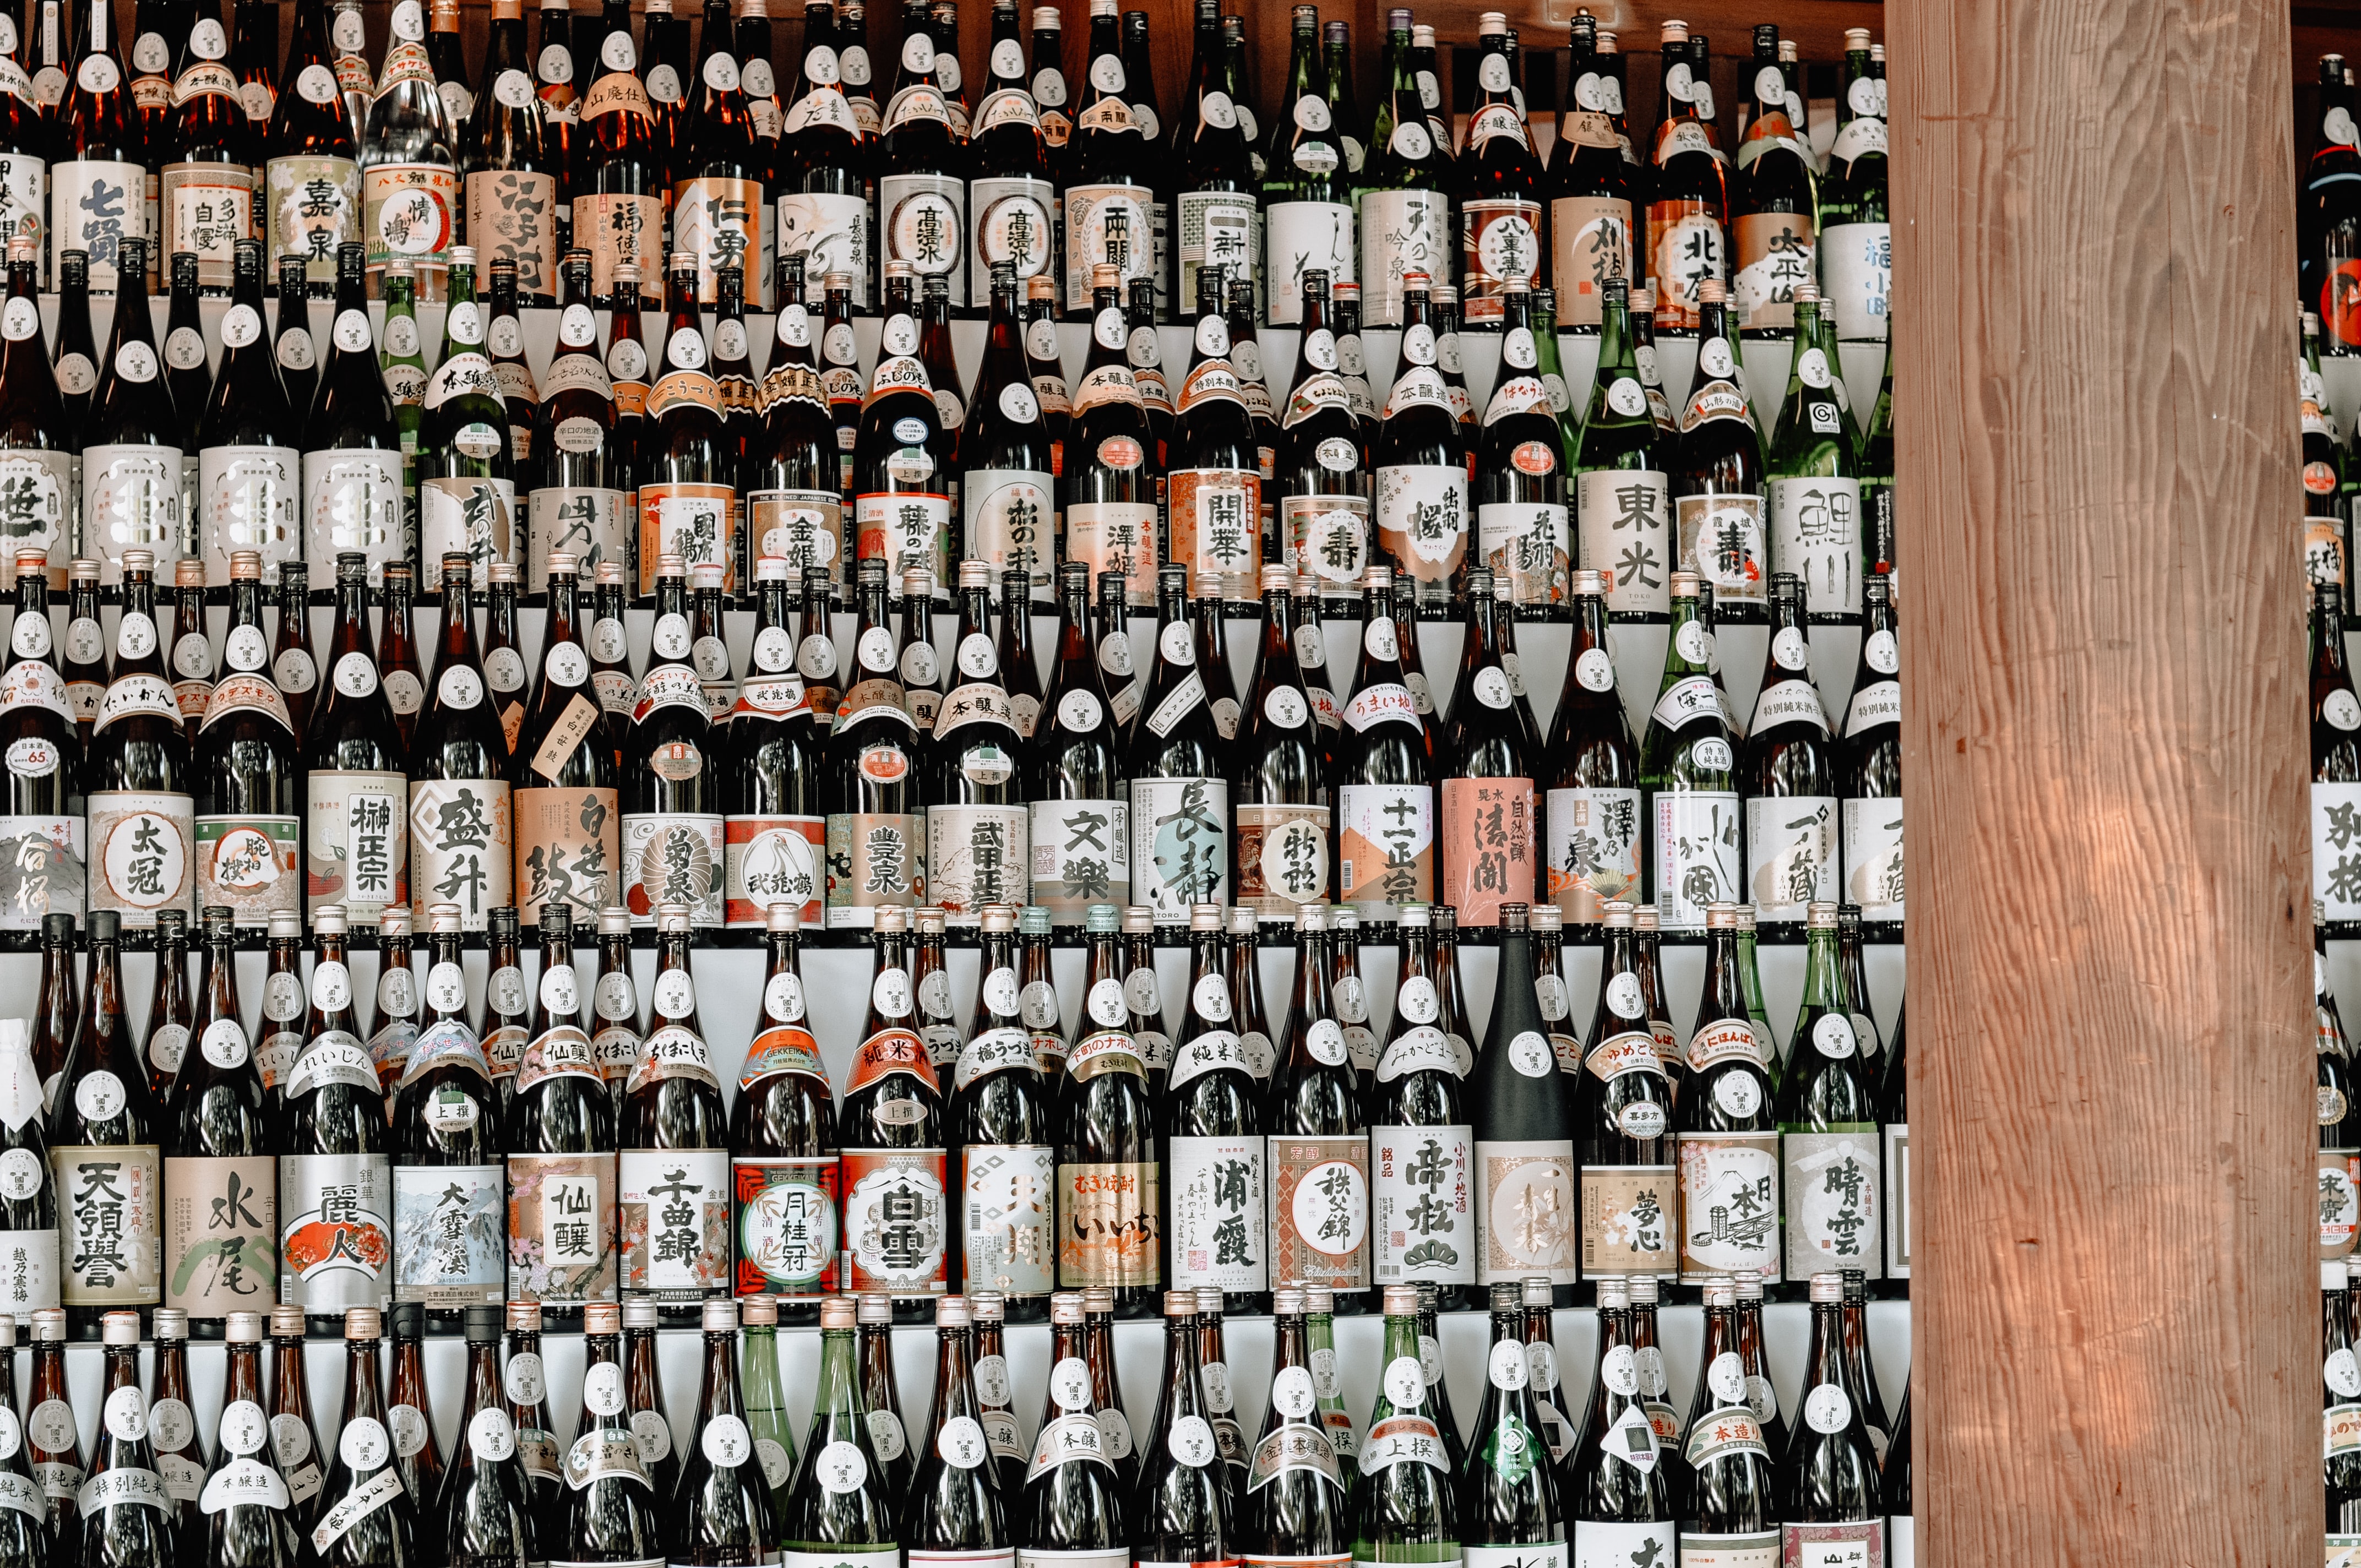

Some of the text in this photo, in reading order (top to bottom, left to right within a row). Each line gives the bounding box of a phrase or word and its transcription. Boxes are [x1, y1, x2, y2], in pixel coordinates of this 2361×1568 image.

[80, 178, 124, 268] 七賢
[301, 178, 341, 263] 嘉泉
[706, 195, 750, 270] 仁勇
[558, 426, 600, 436] 辛口の地酒
[1612, 483, 1662, 589] 東光
[124, 678, 147, 687] 日本酒
[103, 688, 175, 713] たいかん
[28, 751, 46, 764] 65
[1575, 801, 1587, 825] 上撰
[1113, 812, 1127, 860] 本醸造
[1382, 797, 1418, 907] 十一正宗
[127, 816, 168, 896] 太冠
[433, 787, 493, 919] 盛升
[303, 1045, 370, 1072] れいじん
[1192, 1039, 1247, 1068] 純米酒
[437, 1105, 470, 1119] 上撰
[1628, 1110, 1659, 1121] 喜多方
[1291, 1146, 1320, 1160] 芳醇
[1381, 1146, 1394, 1178] 銘品
[358, 1168, 374, 1201] 銀華
[771, 1173, 817, 1182] GEKKEIKAN
[1073, 1173, 1135, 1195] むぎ焼酎
[1405, 1139, 1454, 1236] 帝松
[1454, 1141, 1468, 1214] 小川の地酒
[264, 1195, 274, 1223] 辛口
[646, 1168, 704, 1268] 千曲錦
[1315, 1166, 1352, 1251] 秩父錦
[1823, 1156, 1865, 1257] 晴雲
[206, 1170, 264, 1298] 水尾
[320, 1184, 367, 1266] 麗人
[762, 1215, 774, 1248] 清酒
[780, 1191, 809, 1272] 月桂冠
[880, 1183, 931, 1272] 白雪
[12, 1246, 29, 1306] 越乃寒梅
[607, 1431, 625, 1441] 白梅
[1386, 1436, 1433, 1458] 上撰
[1714, 1423, 1760, 1442] 本造り
[95, 1473, 166, 1499] 特別純米
